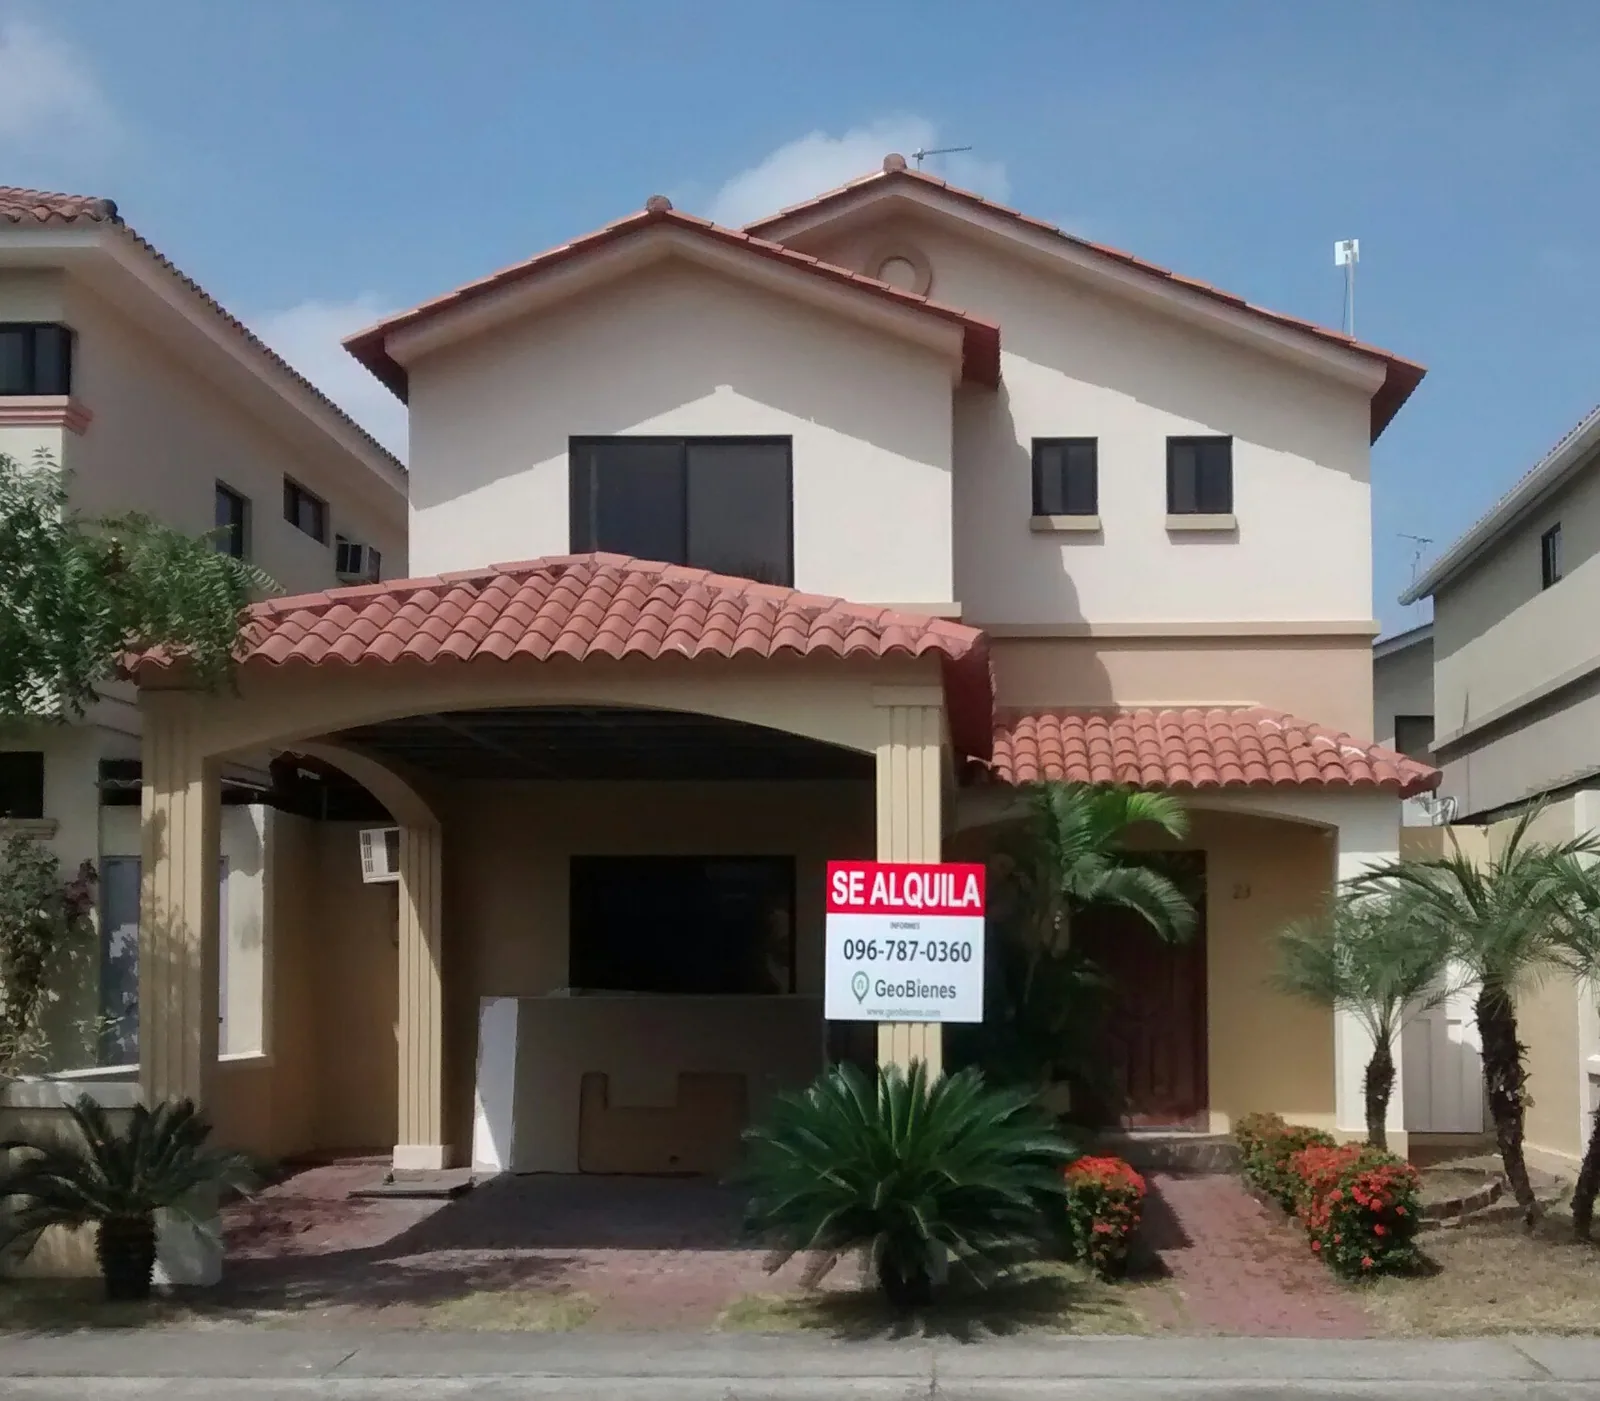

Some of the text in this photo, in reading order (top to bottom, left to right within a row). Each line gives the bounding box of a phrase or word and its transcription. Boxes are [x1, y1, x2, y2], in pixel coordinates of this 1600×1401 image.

[831, 870, 981, 908] SE ALQUILA
[843, 939, 972, 963] 096-787-0360
[875, 979, 957, 999] GeoBienes
